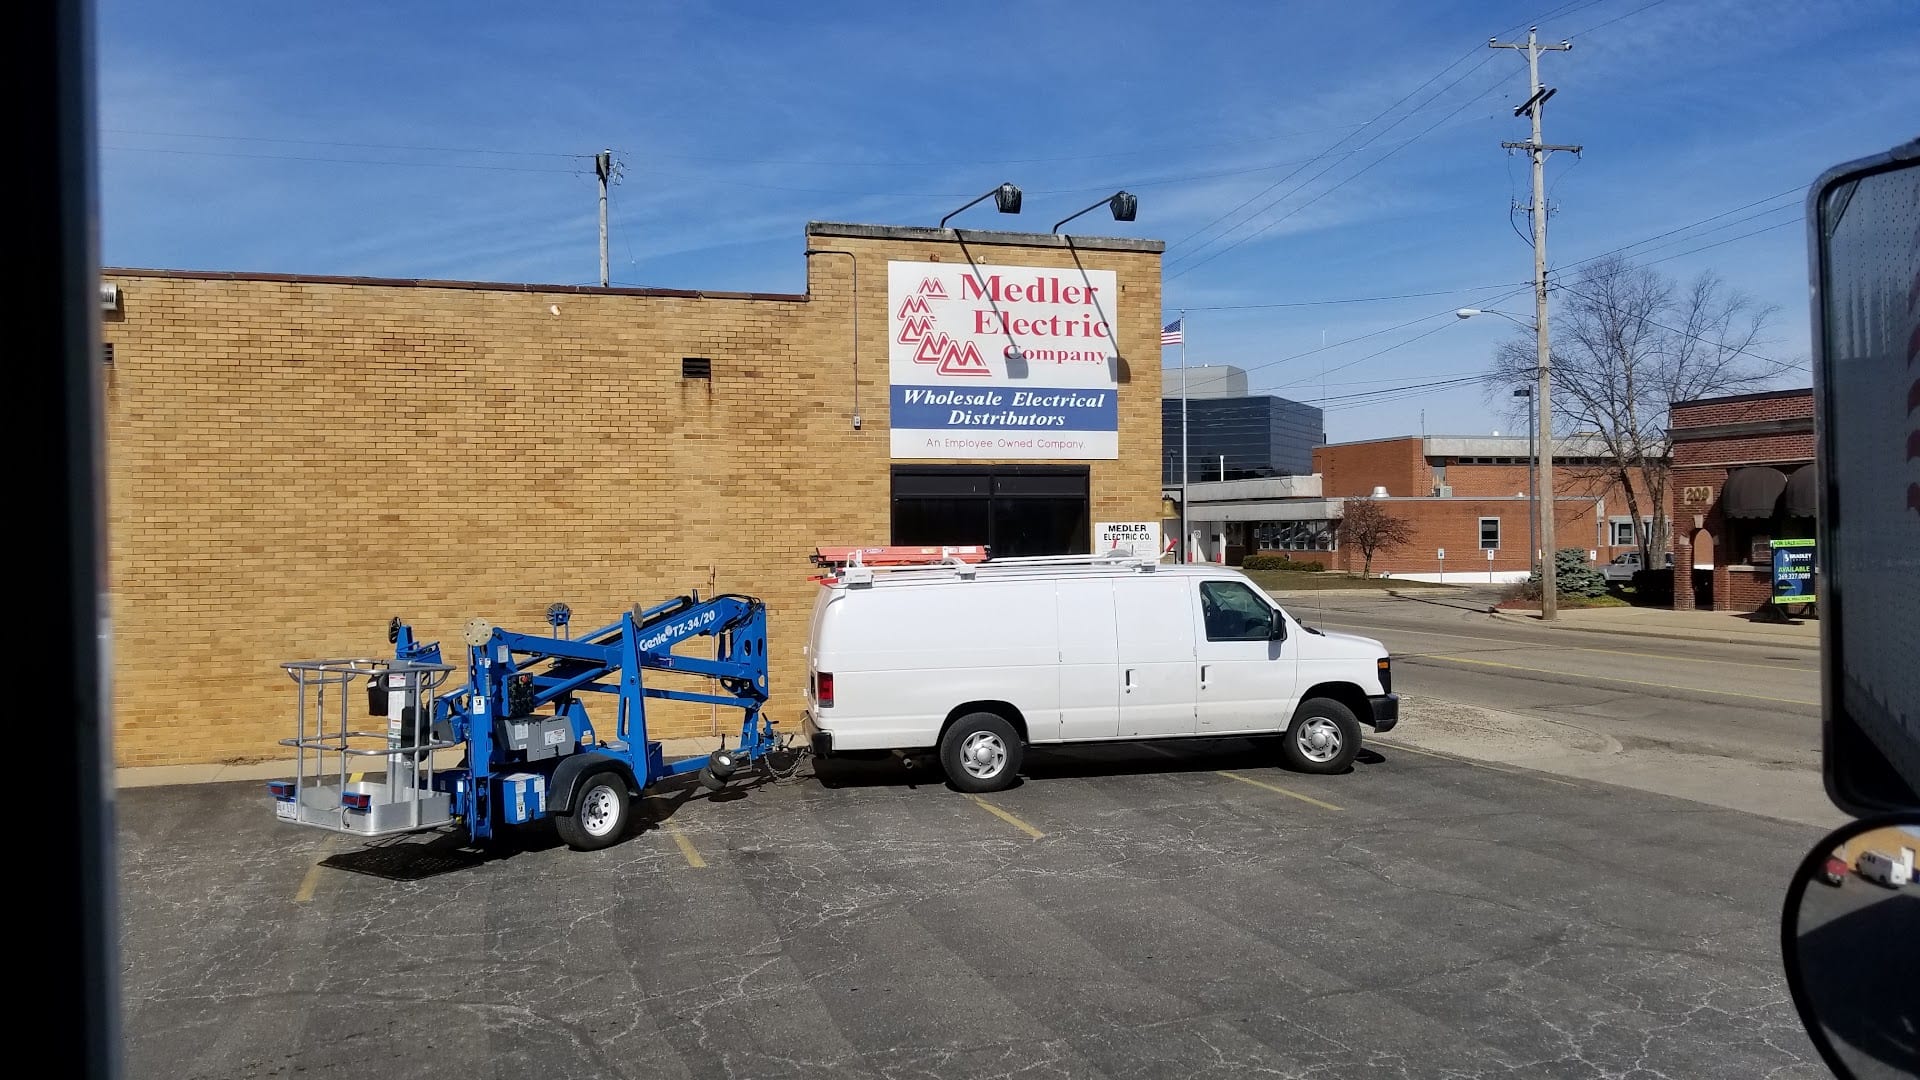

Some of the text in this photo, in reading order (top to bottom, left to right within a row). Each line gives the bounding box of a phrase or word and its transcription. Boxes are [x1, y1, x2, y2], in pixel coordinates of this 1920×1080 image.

[960, 274, 1099, 304] Medler
[973, 309, 1109, 338] Electric
[1003, 344, 1107, 365] Company
[904, 389, 1105, 408] Wholesale Electrical
[948, 410, 1065, 426] Distributors
[926, 438, 1086, 449] An Employee Owned Company.
[1686, 487, 1710, 501] 209
[1108, 524, 1147, 532] MEDLER
[1103, 533, 1152, 541] ELECTRIC CO.
[1778, 565, 1811, 573] AVAILABLE
[640, 610, 715, 652] Genie TZ-34/20
